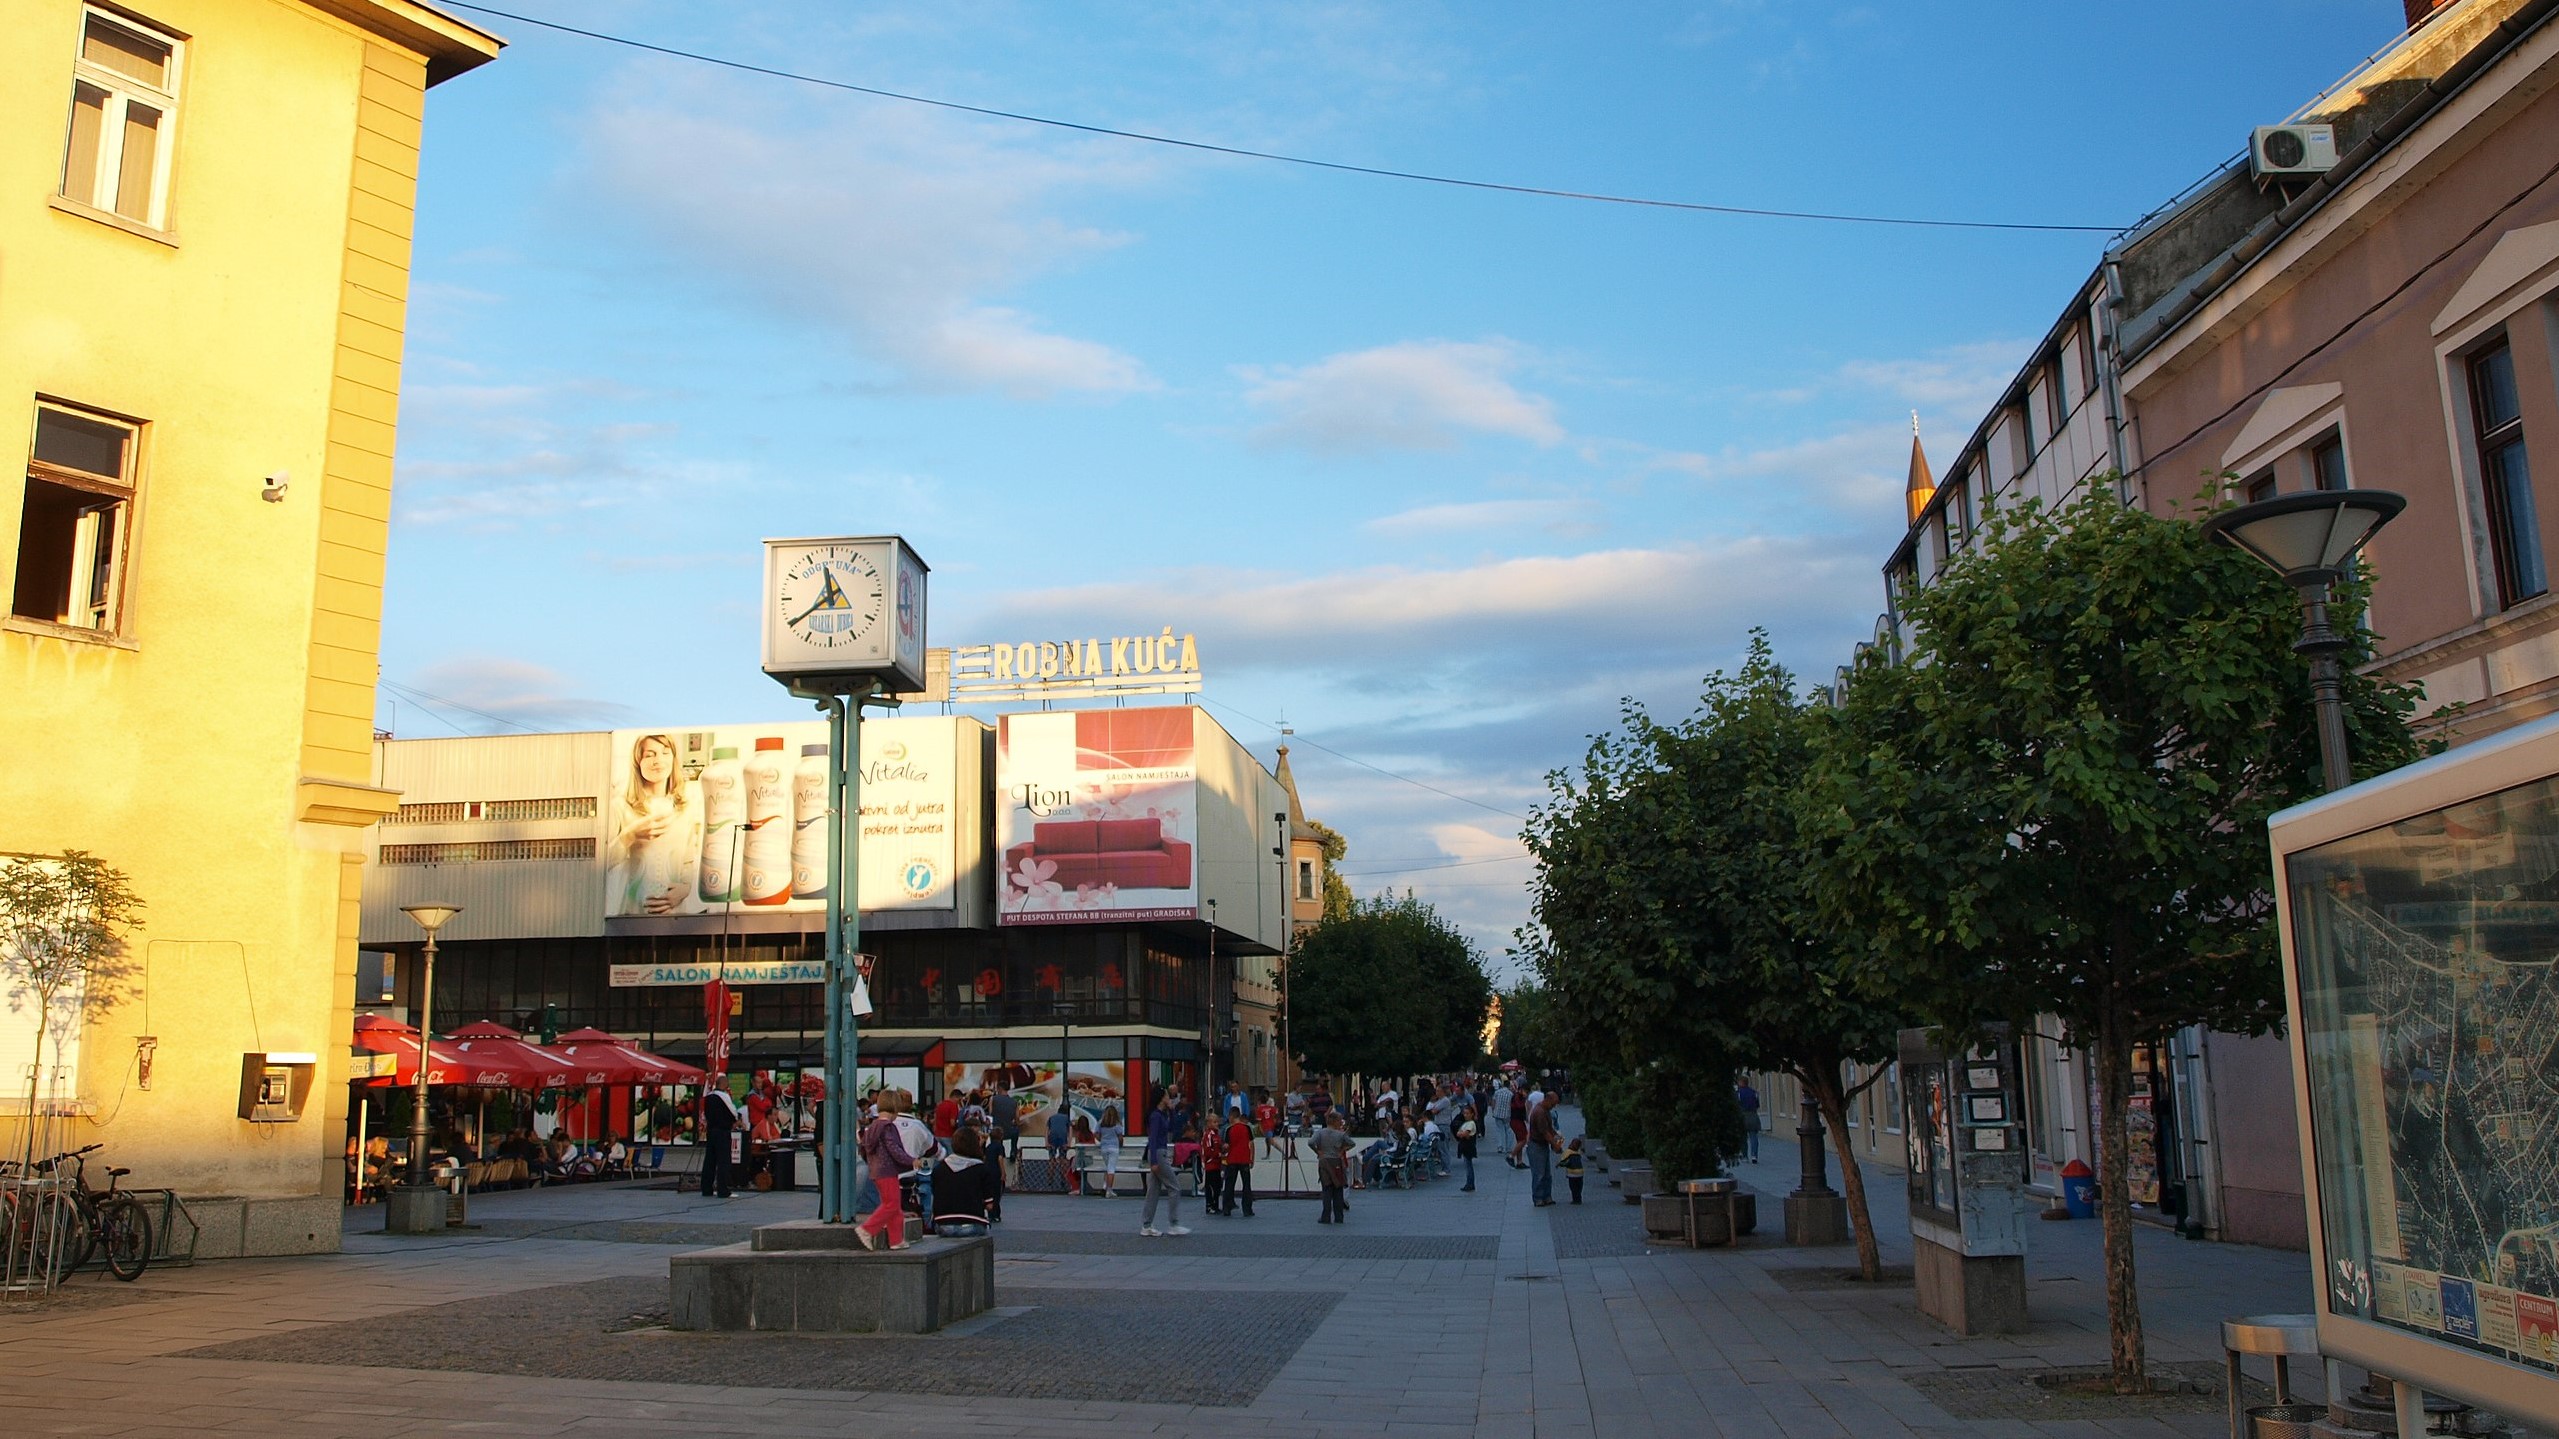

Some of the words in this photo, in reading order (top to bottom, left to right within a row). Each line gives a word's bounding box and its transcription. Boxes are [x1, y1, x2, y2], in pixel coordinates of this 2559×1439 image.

[994, 638, 1103, 680] ROBNA
[1111, 625, 1199, 675] KUĆA
[859, 760, 928, 785] Vitalia
[1106, 772, 1134, 782] SALON
[893, 800, 909, 815] od
[1011, 783, 1071, 817] Lion
[1006, 914, 1022, 923] PUT
[1022, 913, 1055, 922] DESPOTA
[1056, 912, 1088, 921] STEFANA
[1101, 911, 1135, 921] (tranzitni
[1136, 910, 1153, 920] put)
[1153, 908, 1192, 919] GRADIŠKA
[654, 967, 711, 982] SALON
[722, 962, 825, 980] NAMJEŠTAJ
[2519, 1298, 2554, 1317] CENTRUM
